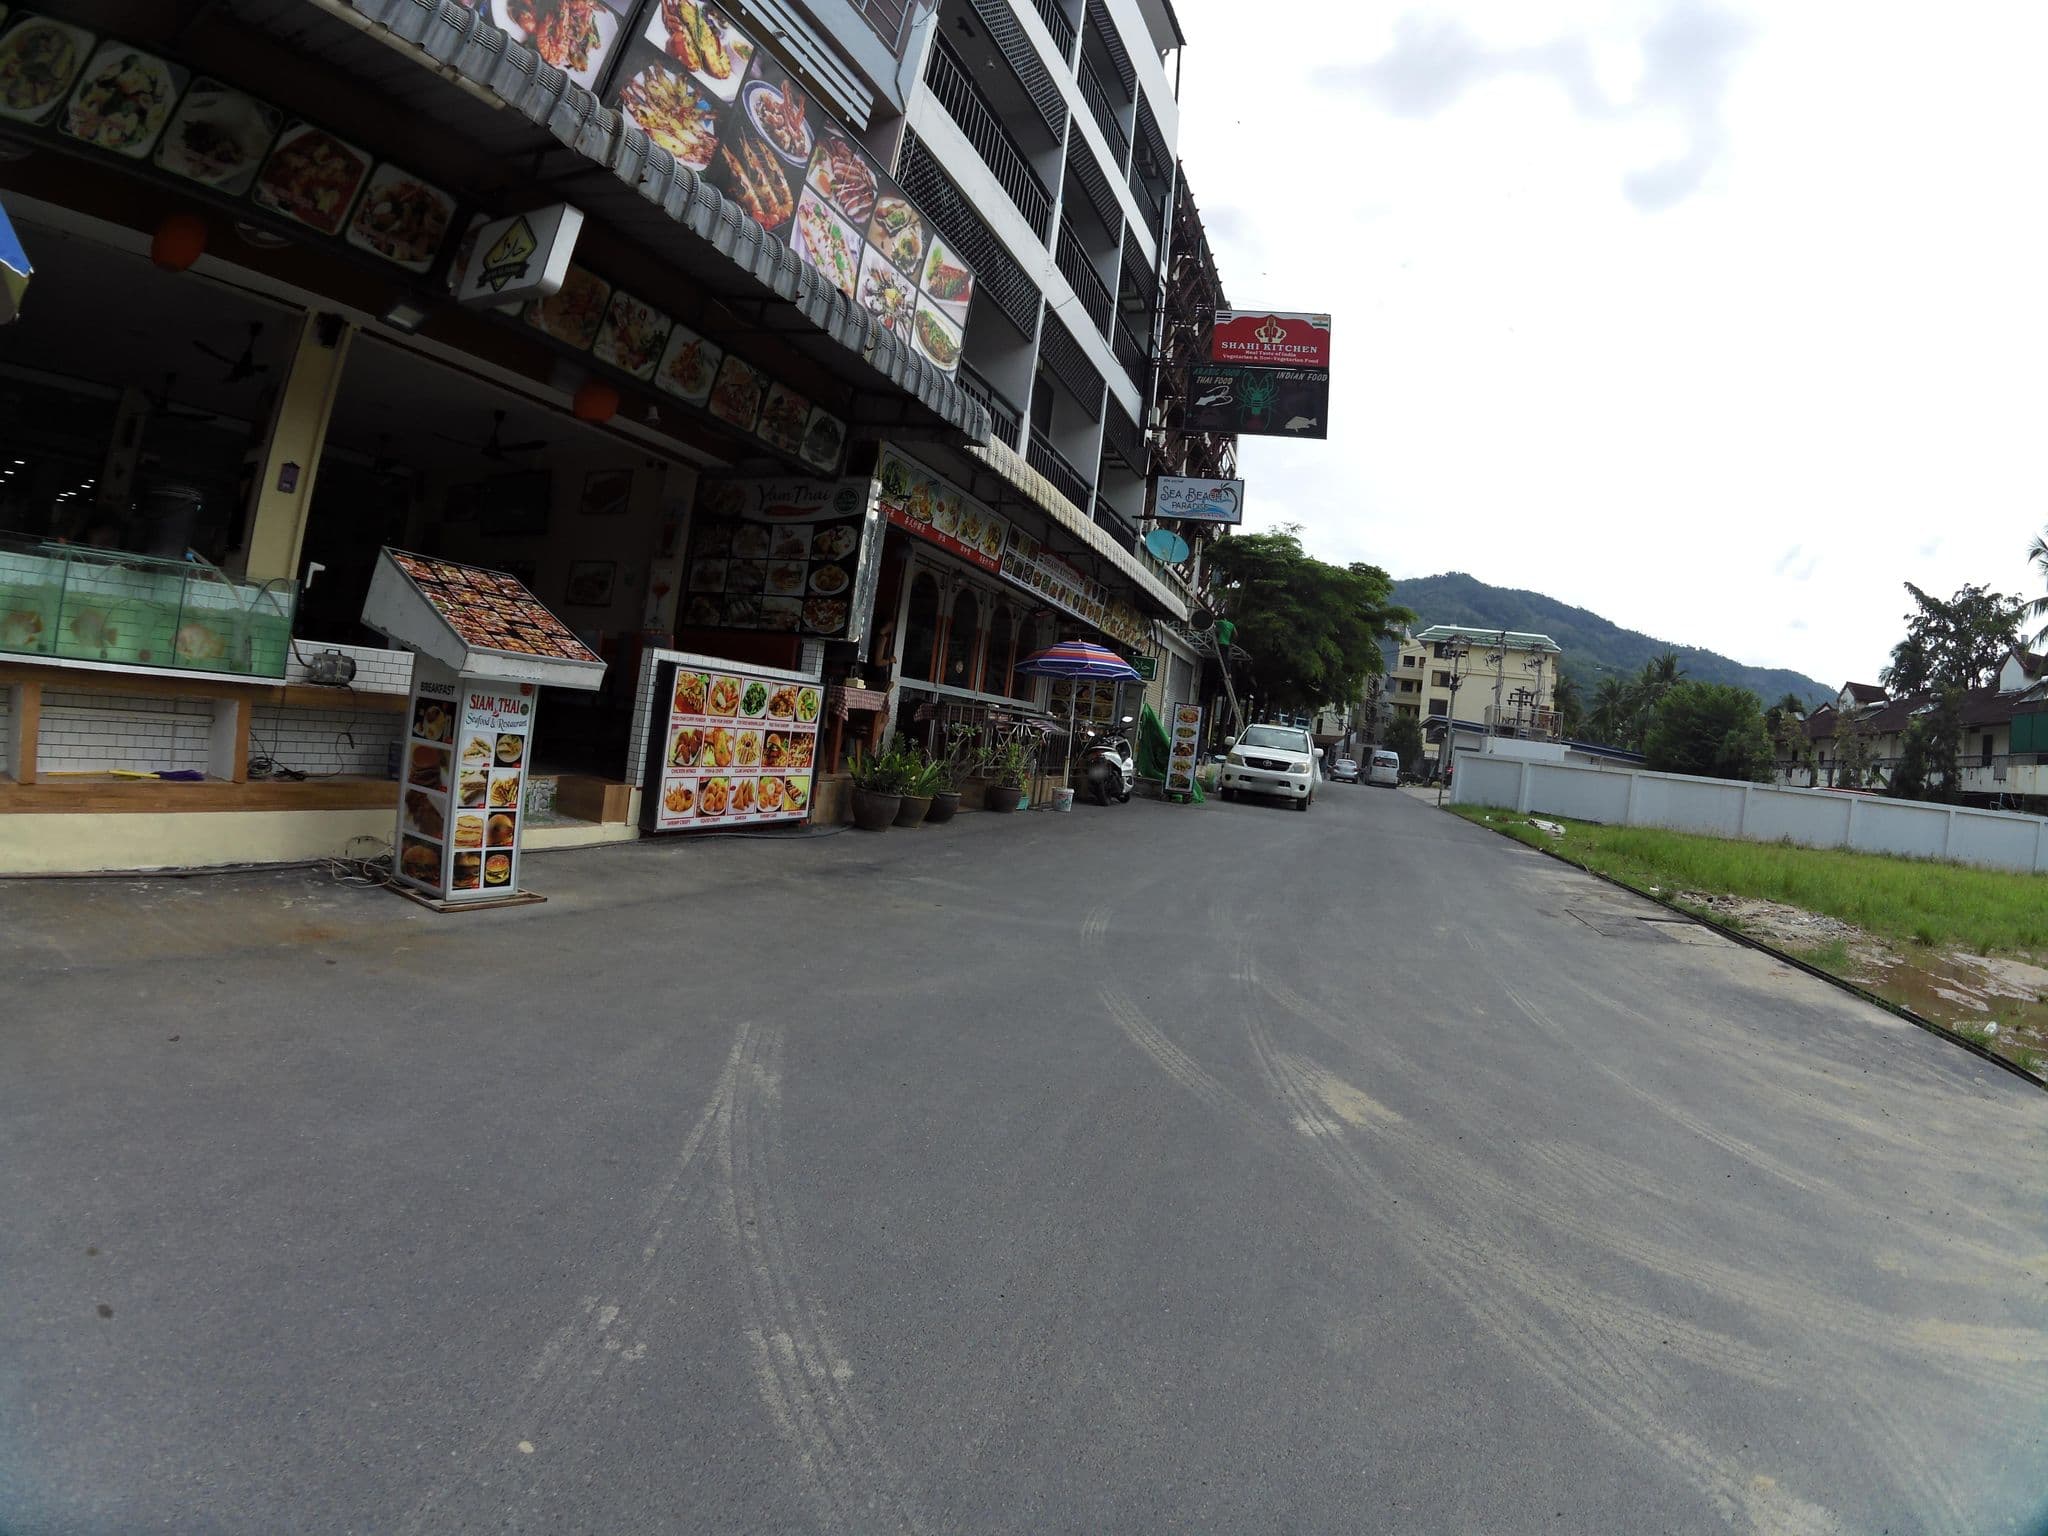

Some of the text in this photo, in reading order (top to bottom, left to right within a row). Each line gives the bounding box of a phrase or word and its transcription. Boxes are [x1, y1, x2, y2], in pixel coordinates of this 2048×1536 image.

[1222, 342, 1318, 353] SHAHI KITCHEN
[1196, 376, 1233, 385] THAI FOOD
[1277, 372, 1328, 382] INDIAN FOOD
[1172, 501, 1208, 510] PARADISE
[420, 682, 455, 696] BREAKFAST
[470, 694, 520, 714] SIAM THAI
[466, 713, 528, 731] Seafood & Restaurant
